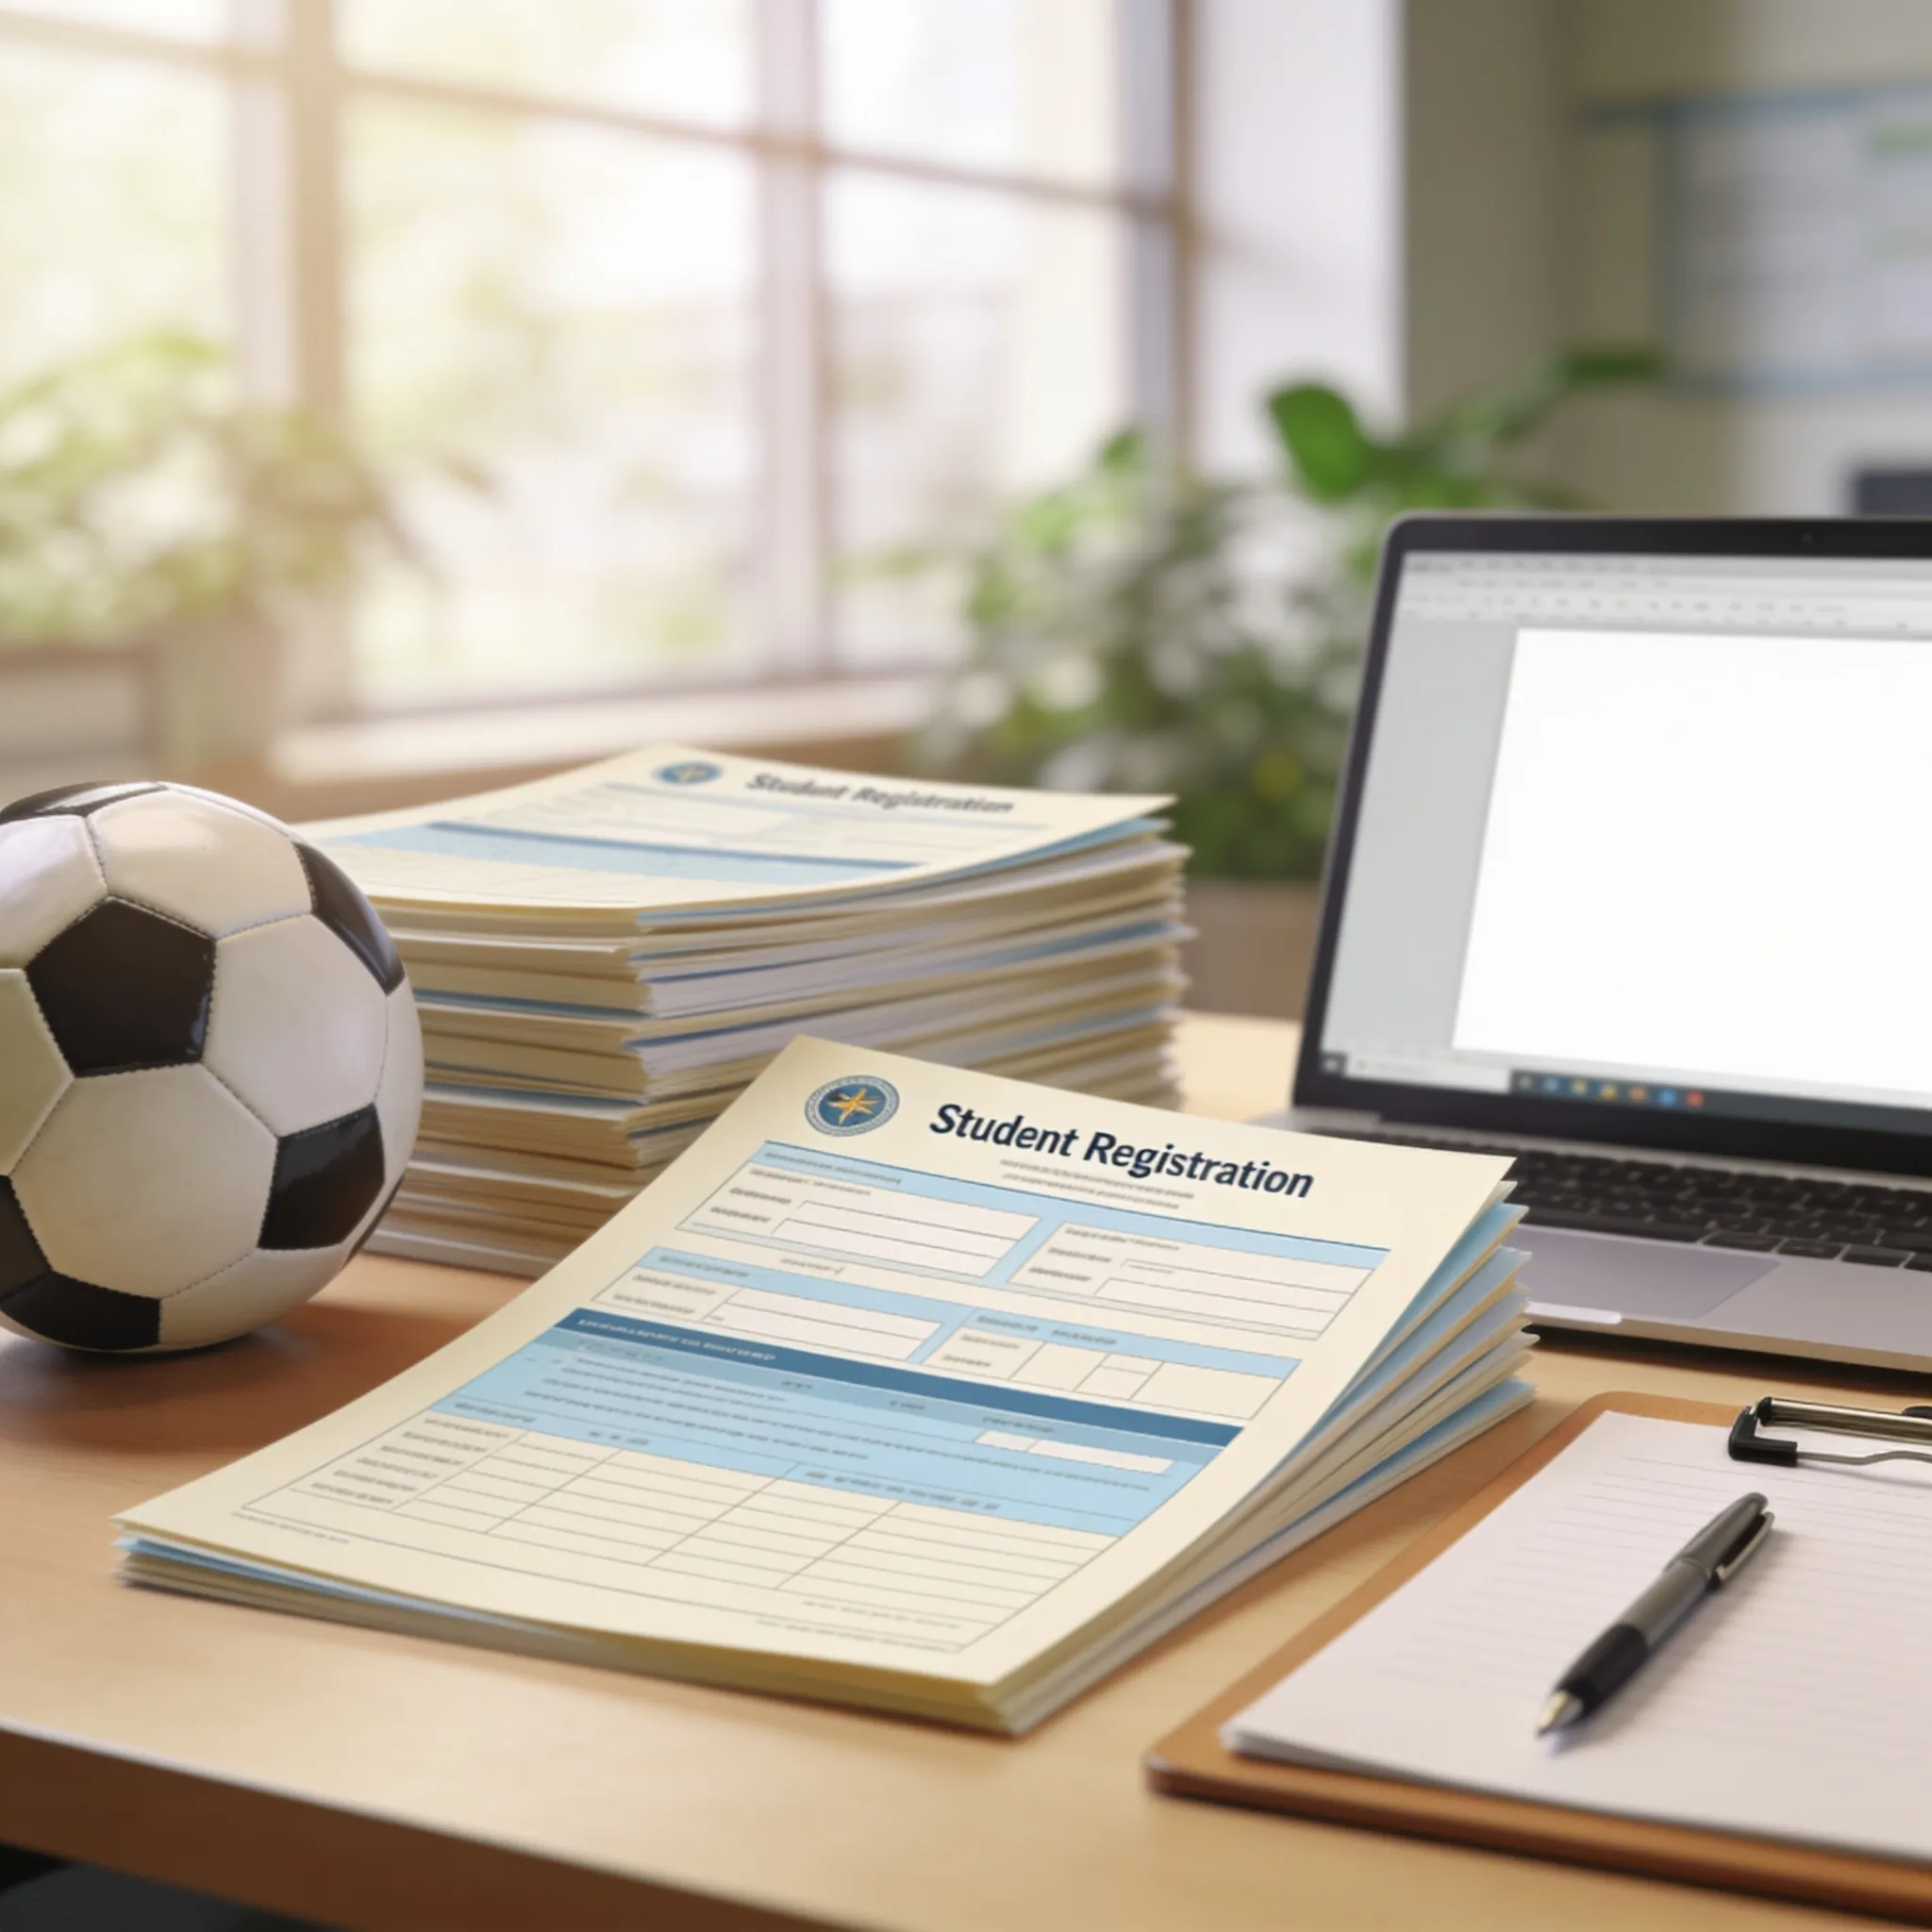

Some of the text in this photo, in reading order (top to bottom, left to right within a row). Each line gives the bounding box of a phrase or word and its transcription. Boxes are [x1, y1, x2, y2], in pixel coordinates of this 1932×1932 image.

[746, 773, 1015, 813] Student Registration
[929, 1102, 1079, 1158] Student
[1082, 1129, 1315, 1199] Registration
